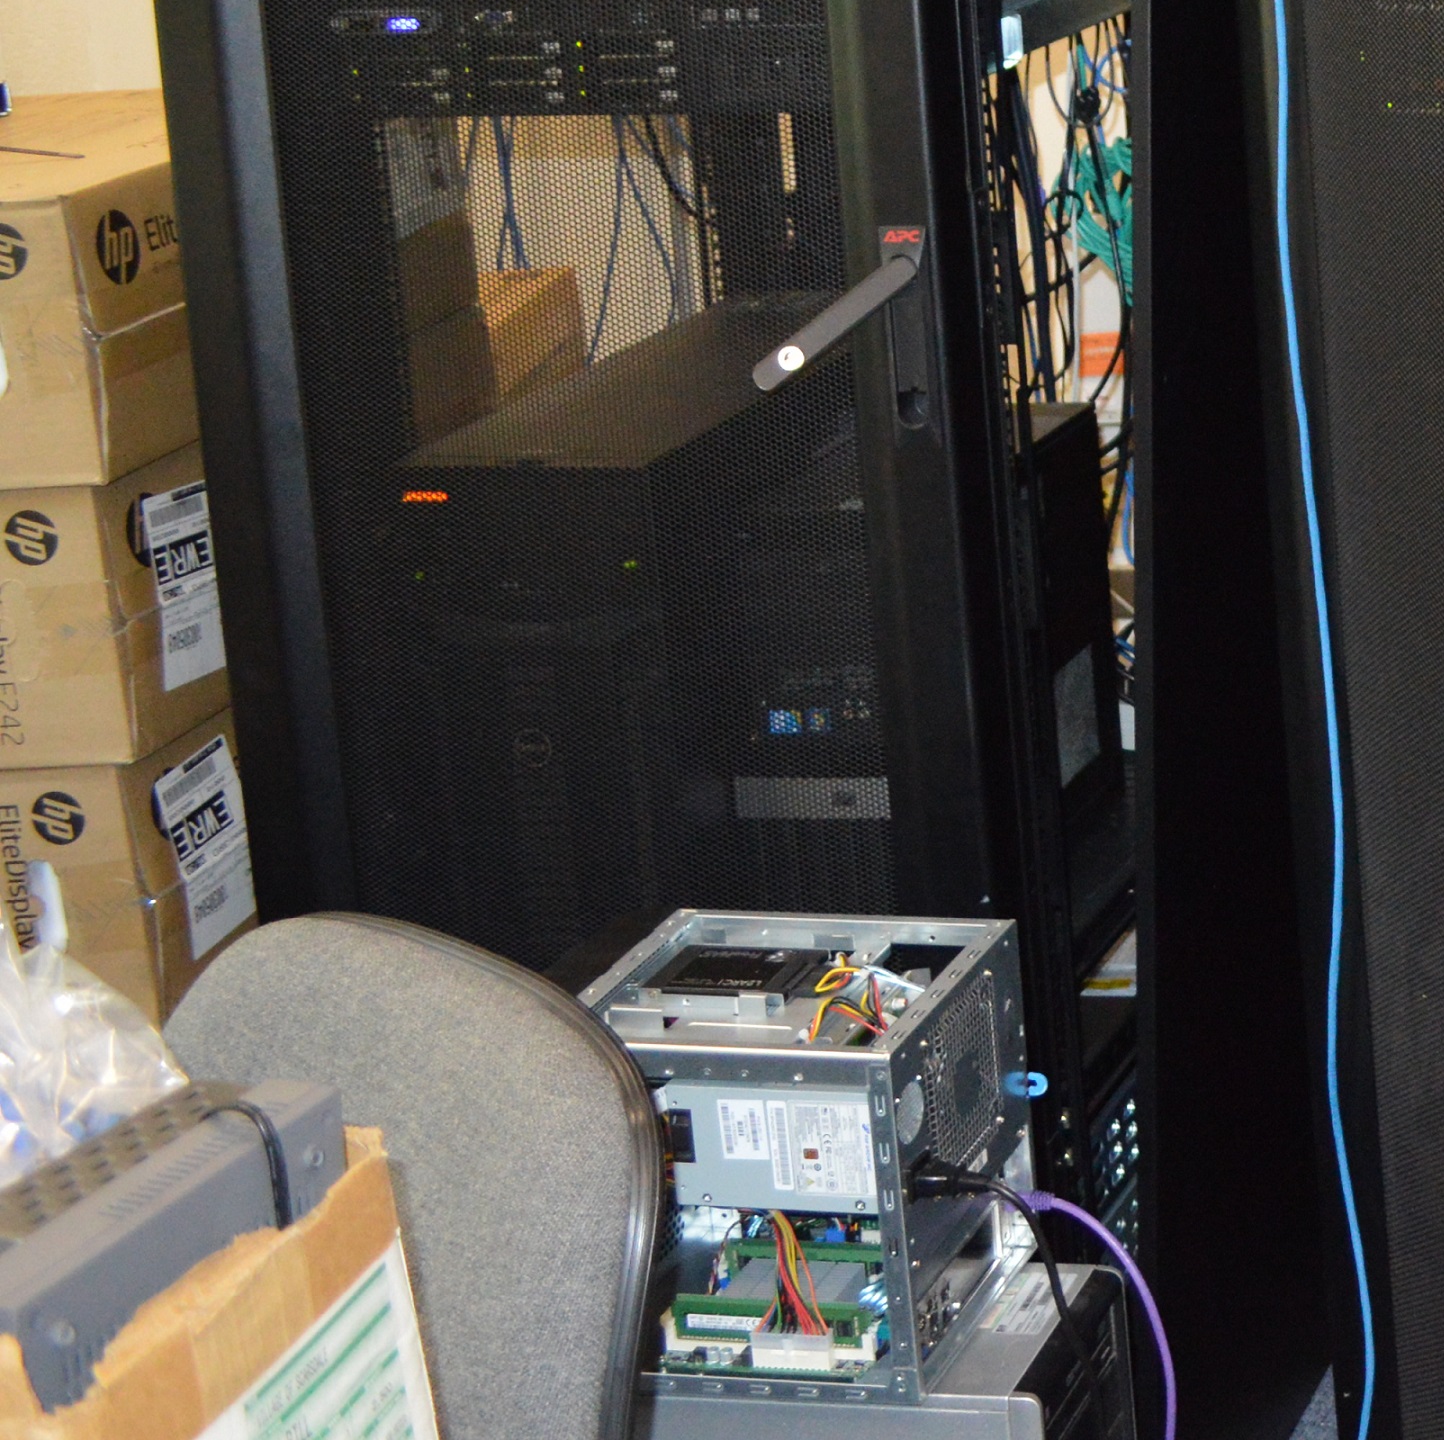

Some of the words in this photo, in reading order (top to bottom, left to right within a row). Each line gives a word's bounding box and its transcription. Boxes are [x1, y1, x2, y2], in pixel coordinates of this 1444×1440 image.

[97, 209, 140, 284] hp
[883, 229, 920, 243] APC
[5, 510, 58, 565] hp
[32, 791, 85, 845] hp
